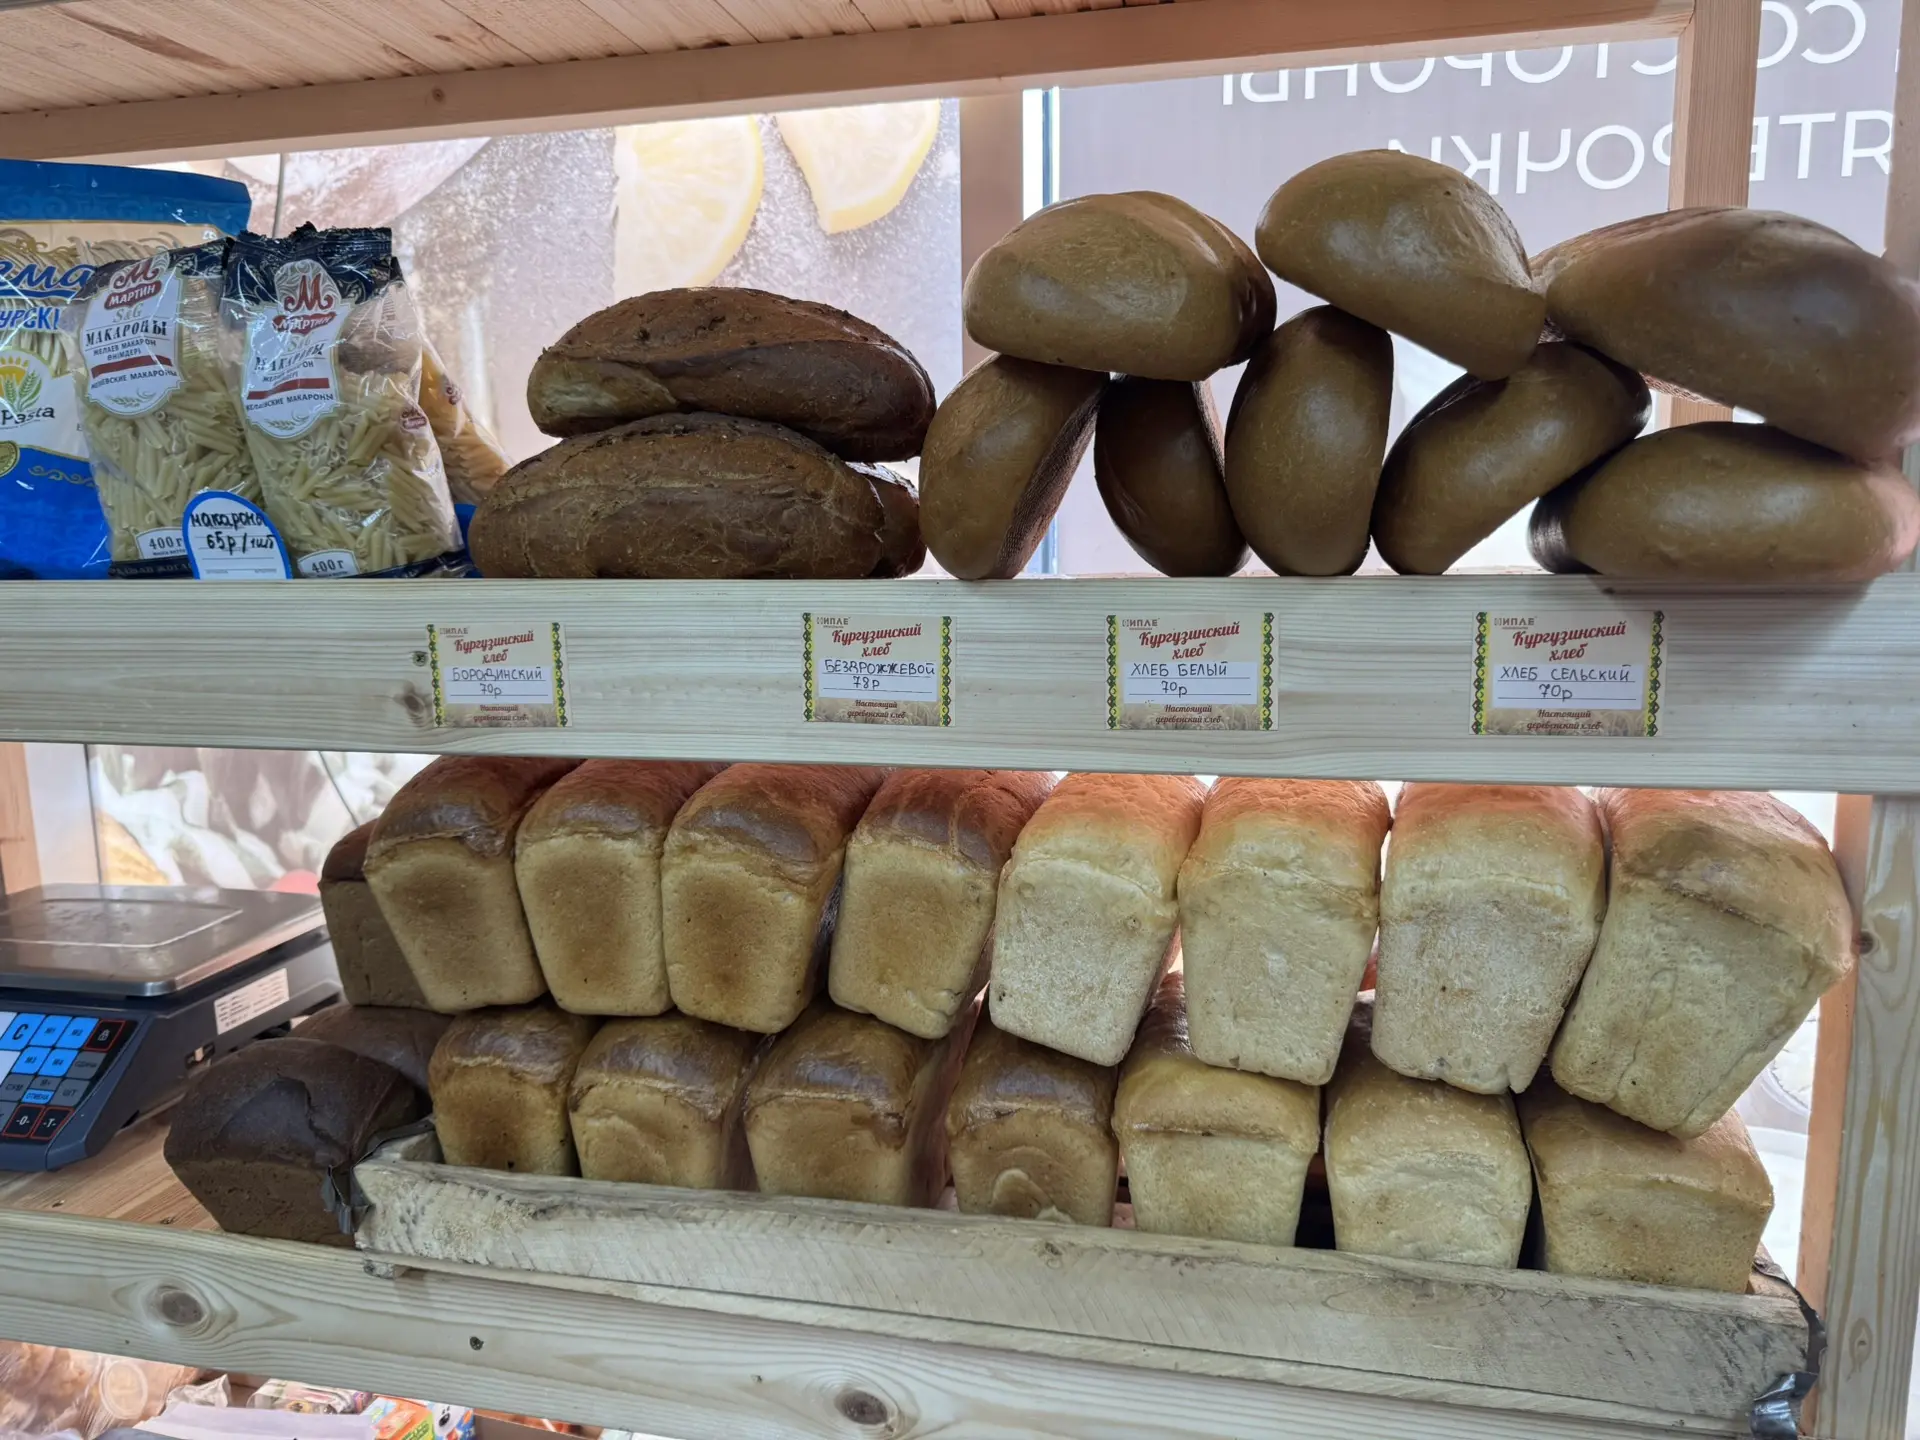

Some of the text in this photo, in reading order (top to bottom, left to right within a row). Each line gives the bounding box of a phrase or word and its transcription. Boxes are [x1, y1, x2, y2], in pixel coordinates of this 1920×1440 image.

[108, 283, 156, 307] МАРТИН
[86, 320, 168, 347] МАКАРОНЫ
[121, 338, 157, 351] МАКАРОН
[287, 393, 334, 404] МАКАРОНЫ
[1, 406, 56, 426] Pasta
[149, 536, 174, 550] 400
[312, 559, 336, 573] 400
[454, 630, 535, 654] Кургузинский
[832, 623, 922, 646] Кургузинский
[1139, 621, 1241, 649] Кургузинский
[1512, 620, 1627, 649] Кургузинский
[482, 649, 509, 664] хлеб
[861, 642, 892, 657] хлеб
[1172, 642, 1207, 660] хлеб
[1549, 643, 1588, 662] хлеб
[452, 666, 542, 682] БОРОДИНСКИЙ
[1131, 661, 1229, 677] ХЛЕБ БЕЛЫЙ
[1500, 664, 1632, 682] ХЛЕБ СЕЛЬСКИЙ
[855, 700, 898, 710] Настоящий
[1164, 704, 1212, 715] Настоящий
[847, 709, 907, 719] деревенский хлеб
[1155, 714, 1222, 724] деревенский хлеб
[1537, 709, 1591, 719] Настоящий
[1527, 721, 1602, 731] деревенский хлеб
